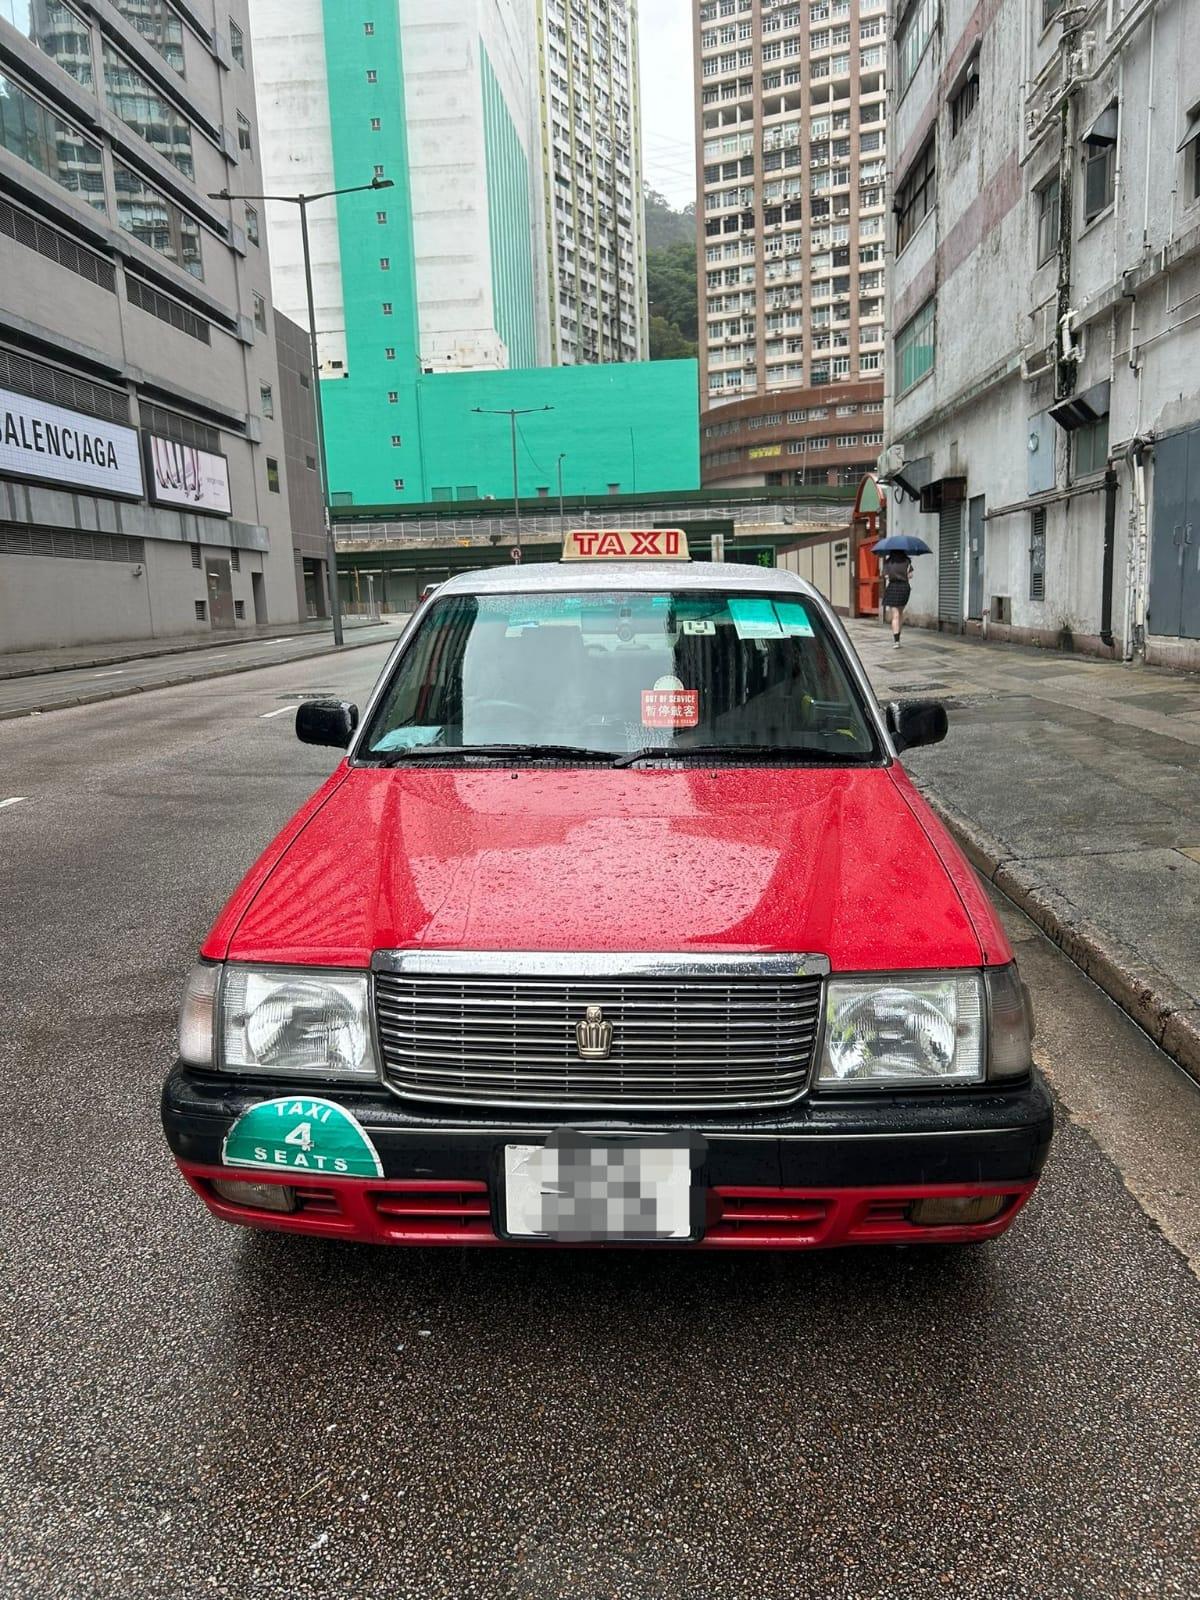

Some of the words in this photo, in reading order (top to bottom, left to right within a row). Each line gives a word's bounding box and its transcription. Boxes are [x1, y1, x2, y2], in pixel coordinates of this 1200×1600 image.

[0, 411, 119, 470] ALENCIAGA
[573, 532, 679, 555] TAXI
[669, 695, 696, 703] SERVICE
[274, 1102, 333, 1123] TAXI
[285, 1122, 313, 1151] 4
[254, 1147, 348, 1172] SEATS
